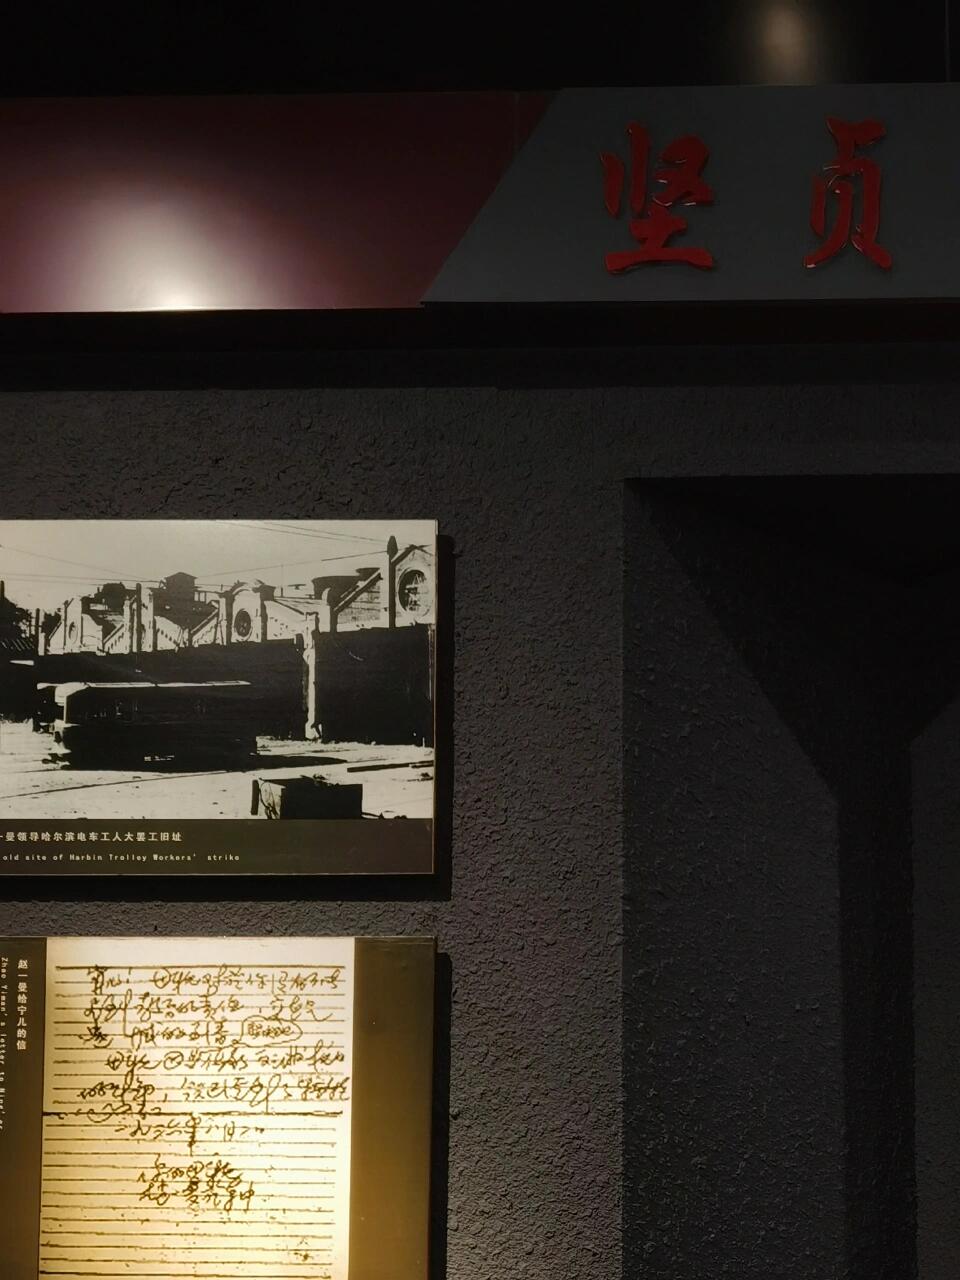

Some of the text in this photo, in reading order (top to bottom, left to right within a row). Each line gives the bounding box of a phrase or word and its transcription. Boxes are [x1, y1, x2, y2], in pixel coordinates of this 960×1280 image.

[3, 853, 20, 861] old
[25, 853, 48, 861] site
[52, 853, 64, 861] of
[69, 853, 103, 861] Harbin
[109, 853, 147, 862] Trolley
[207, 853, 240, 861] strike
[17, 959, 28, 1050] 赵一曼给宁儿的信
